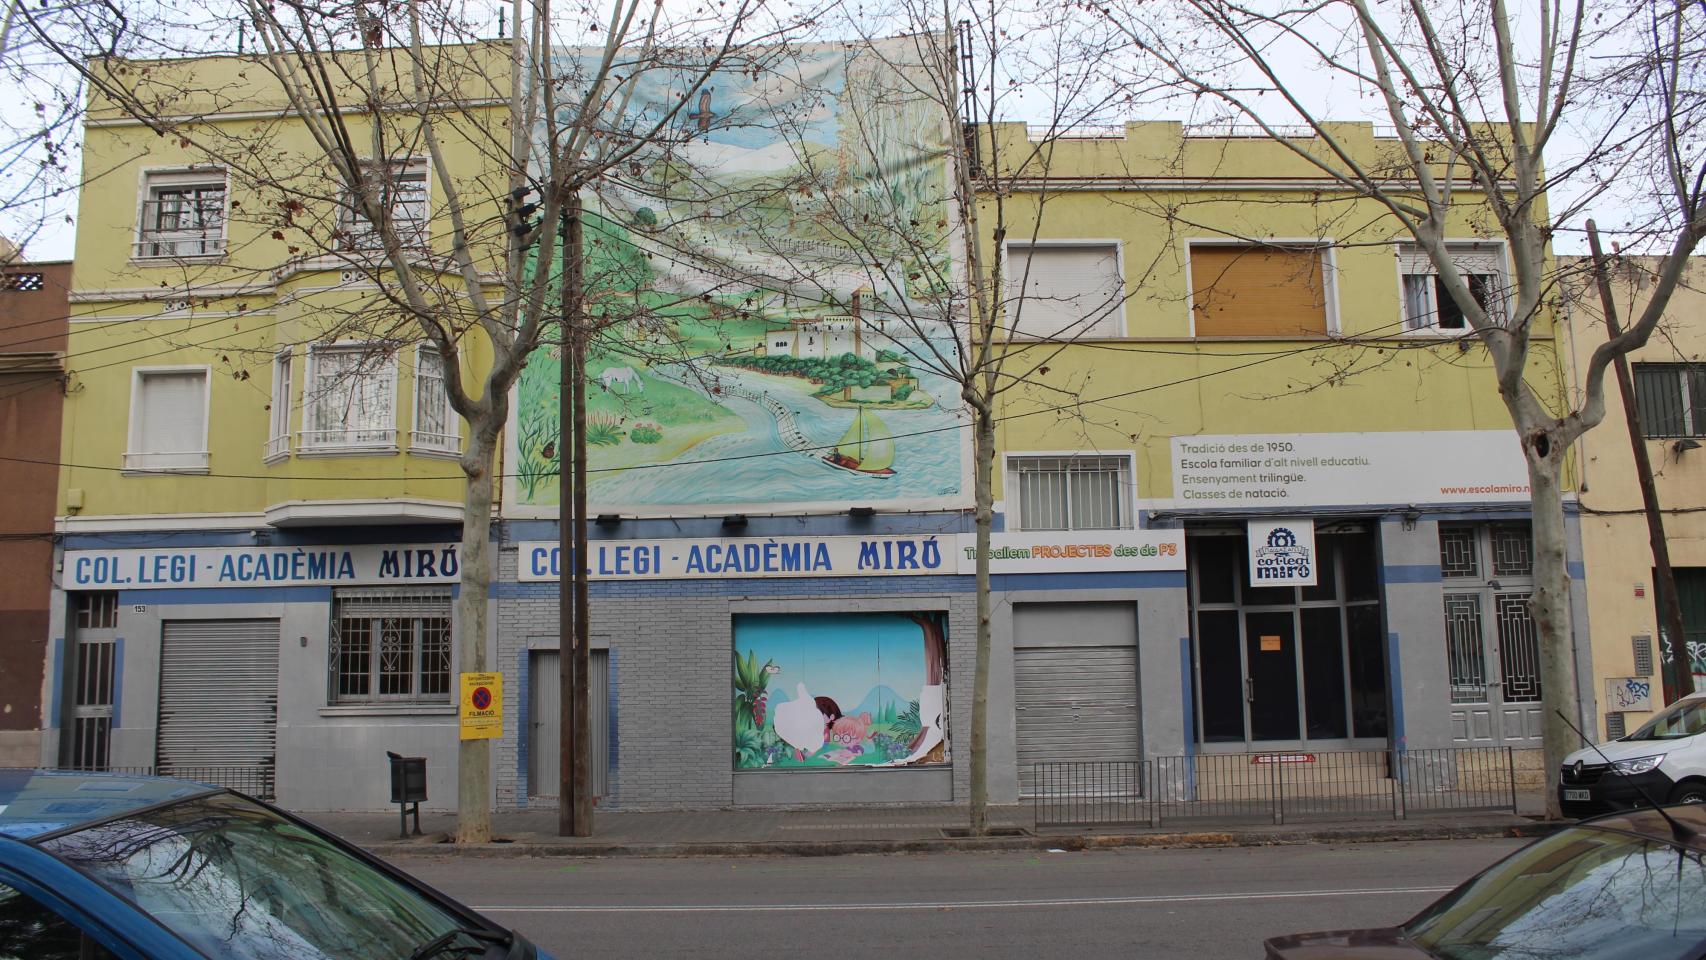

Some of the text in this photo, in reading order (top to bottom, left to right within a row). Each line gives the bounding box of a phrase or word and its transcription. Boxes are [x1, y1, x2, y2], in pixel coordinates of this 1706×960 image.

[1180, 442, 1296, 454] Tradició des de 1950.
[1181, 455, 1371, 469] Escola familiar d'alt nivell educatiu.
[1182, 472, 1307, 485] Ensenyament trilingüe.
[1183, 488, 1290, 500] Classes de natació.
[1440, 484, 1534, 494] www.escolamiro.n
[685, 538, 833, 574] ACADÈMIA
[857, 535, 942, 570] MIRÓ
[1031, 543, 1112, 559] PROJECTES
[1113, 544, 1138, 557] des
[1139, 543, 1158, 556] de
[1159, 543, 1178, 556] P3
[218, 547, 356, 582] ACADÈMIA
[379, 545, 457, 578] MIRÓ
[1256, 564, 1310, 579] miró
[134, 605, 146, 613] 153
